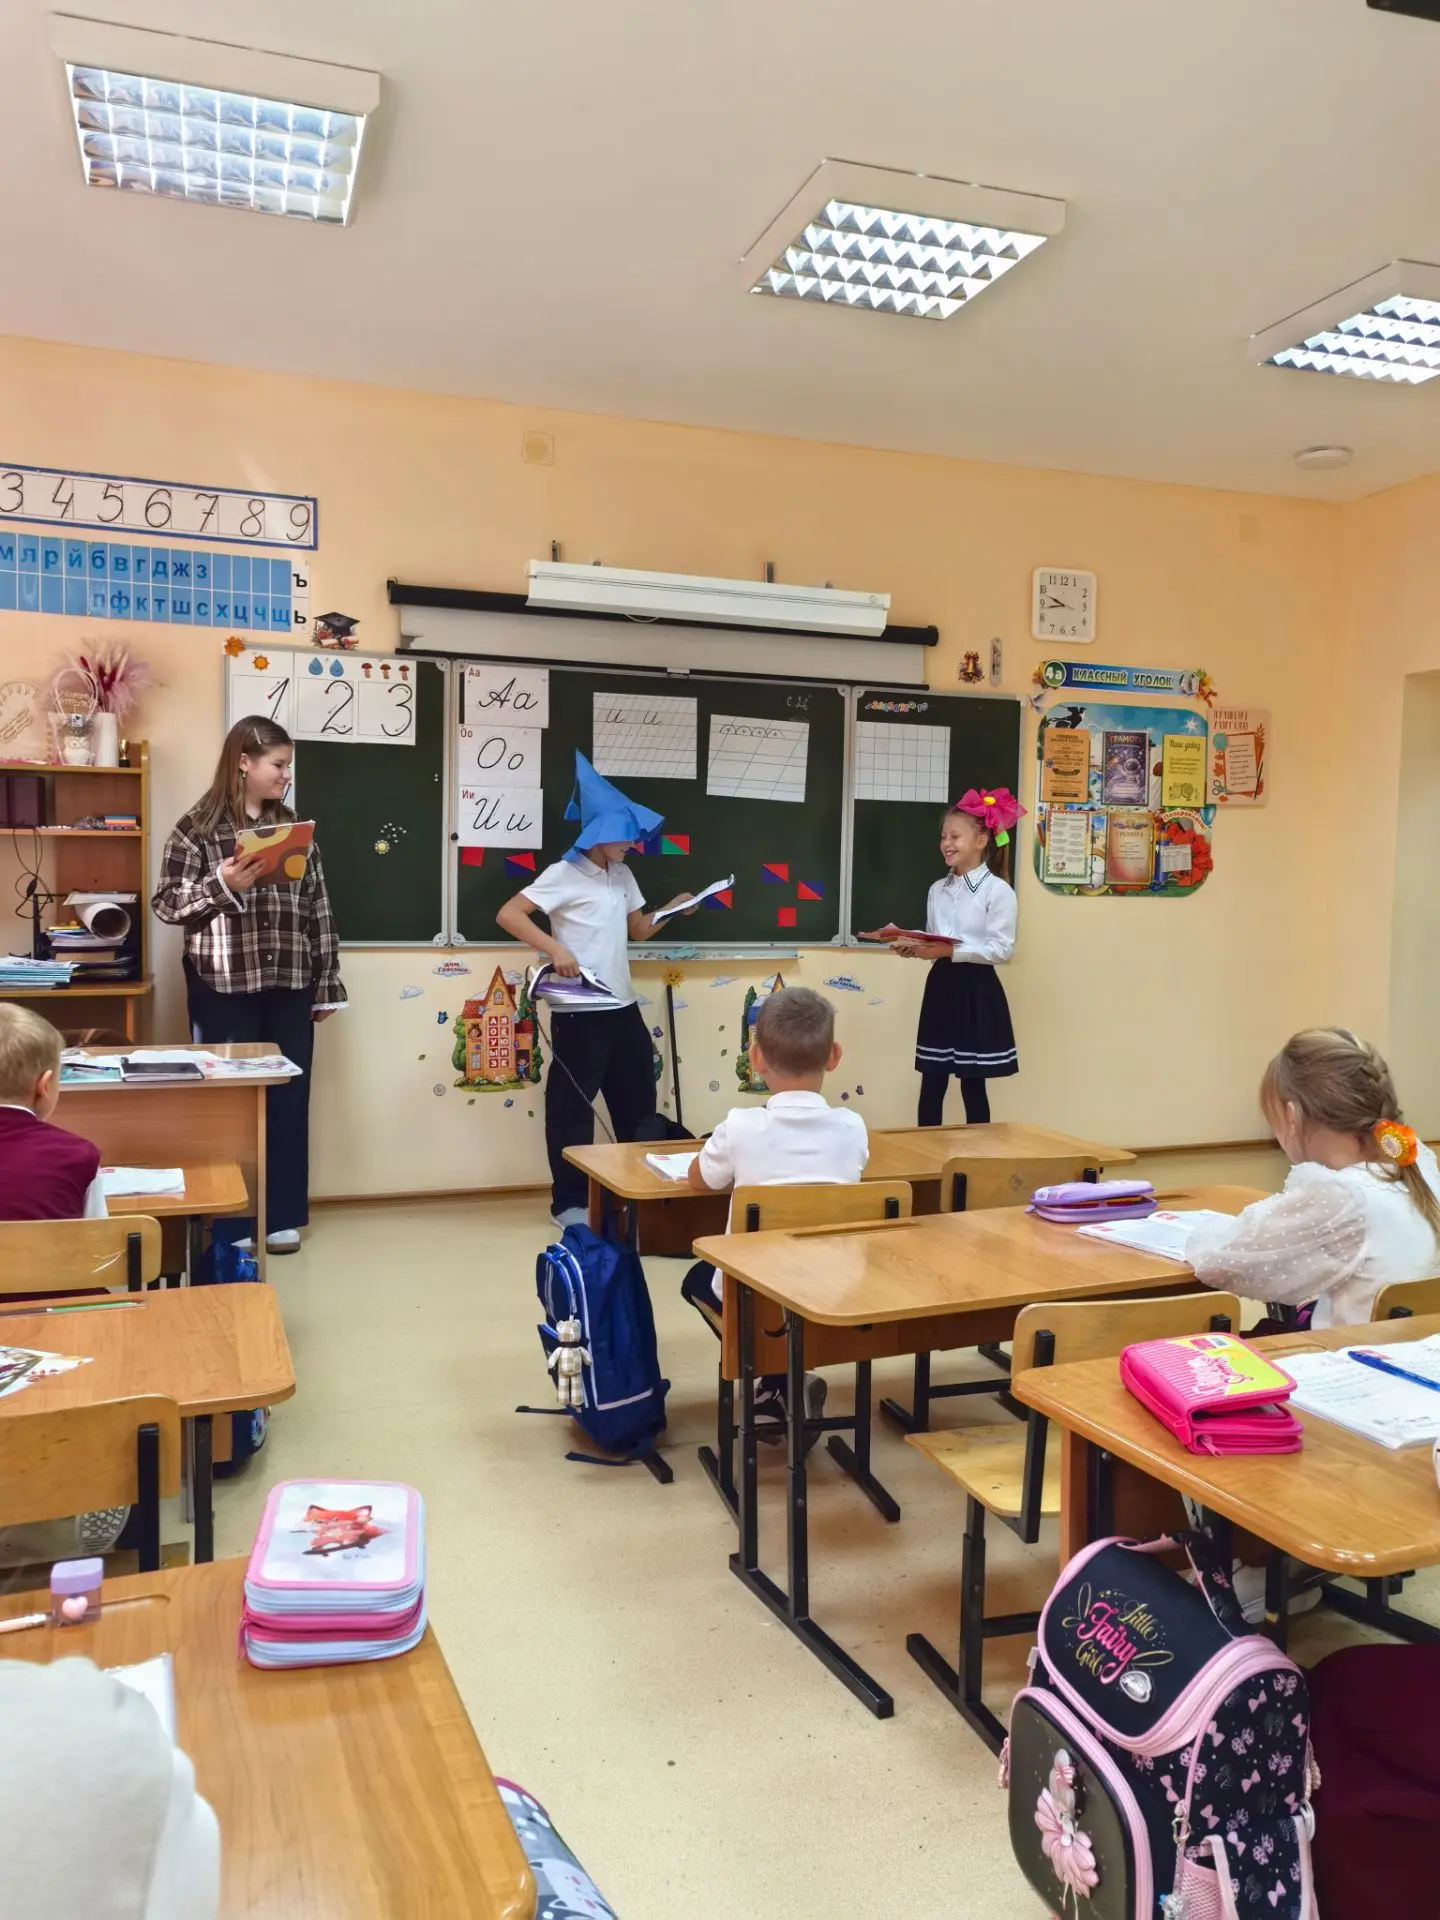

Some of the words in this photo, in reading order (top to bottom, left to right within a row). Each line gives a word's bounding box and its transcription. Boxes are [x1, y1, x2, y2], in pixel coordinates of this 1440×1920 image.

[0, 472, 24, 512] 3
[52, 477, 74, 518] 4
[97, 483, 124, 522] 5
[145, 488, 172, 528] 6
[195, 493, 219, 532] 7
[240, 499, 265, 537] 8
[286, 503, 310, 541] 9
[1060, 575, 1069, 586] 12
[1072, 667, 1128, 685] КЛАССНЫЙ
[1133, 672, 1173, 688] УГОЛОК
[321, 680, 354, 734] 2
[381, 683, 413, 737] 3
[1117, 1600, 1159, 1641] Little
[1075, 1640, 1107, 1677] Girl
[1076, 1602, 1137, 1684] Fairy
